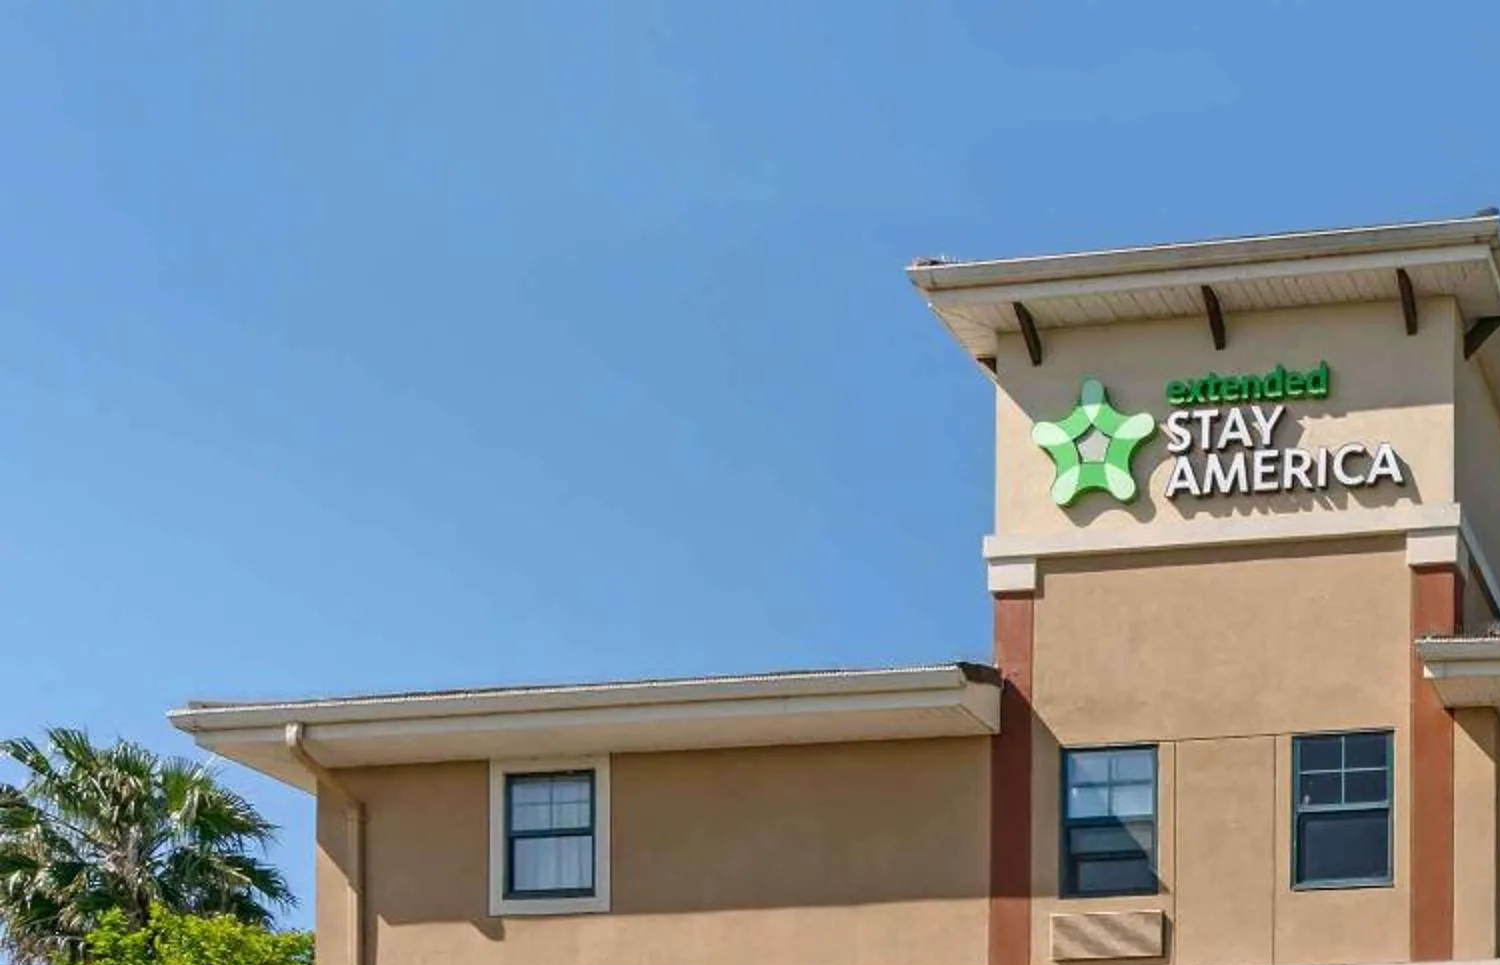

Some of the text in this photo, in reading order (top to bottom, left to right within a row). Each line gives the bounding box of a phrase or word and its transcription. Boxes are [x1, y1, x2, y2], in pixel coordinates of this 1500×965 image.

[1166, 360, 1330, 405] extended
[1167, 405, 1285, 452] STAY
[1165, 443, 1404, 497] AMERICA
